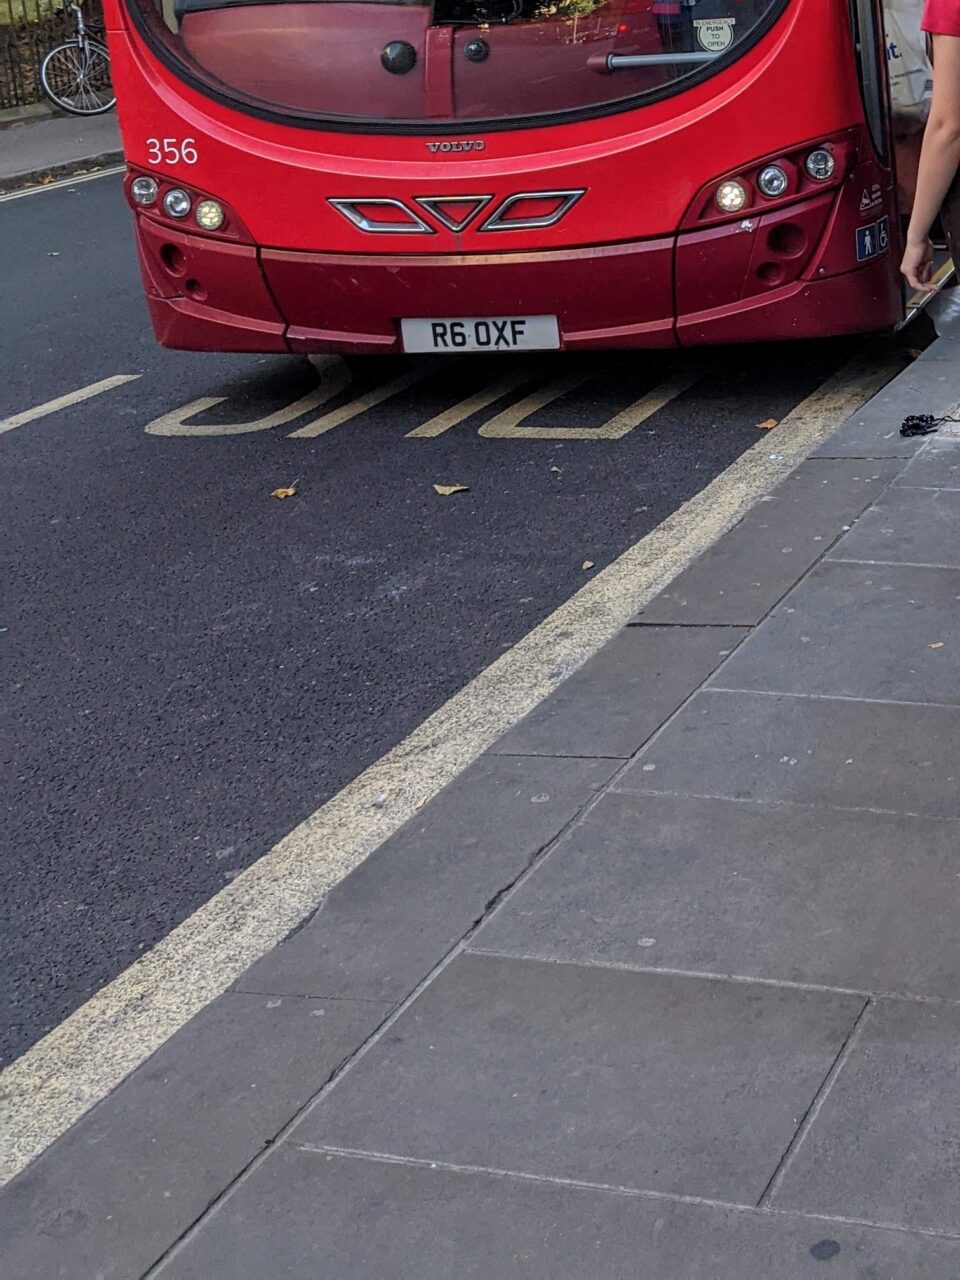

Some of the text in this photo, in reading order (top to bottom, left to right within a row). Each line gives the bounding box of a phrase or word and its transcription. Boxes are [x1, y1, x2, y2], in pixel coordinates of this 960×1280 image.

[146, 138, 198, 164] 356
[426, 140, 485, 153] VOLVO
[431, 319, 526, 348] R6 OXF
